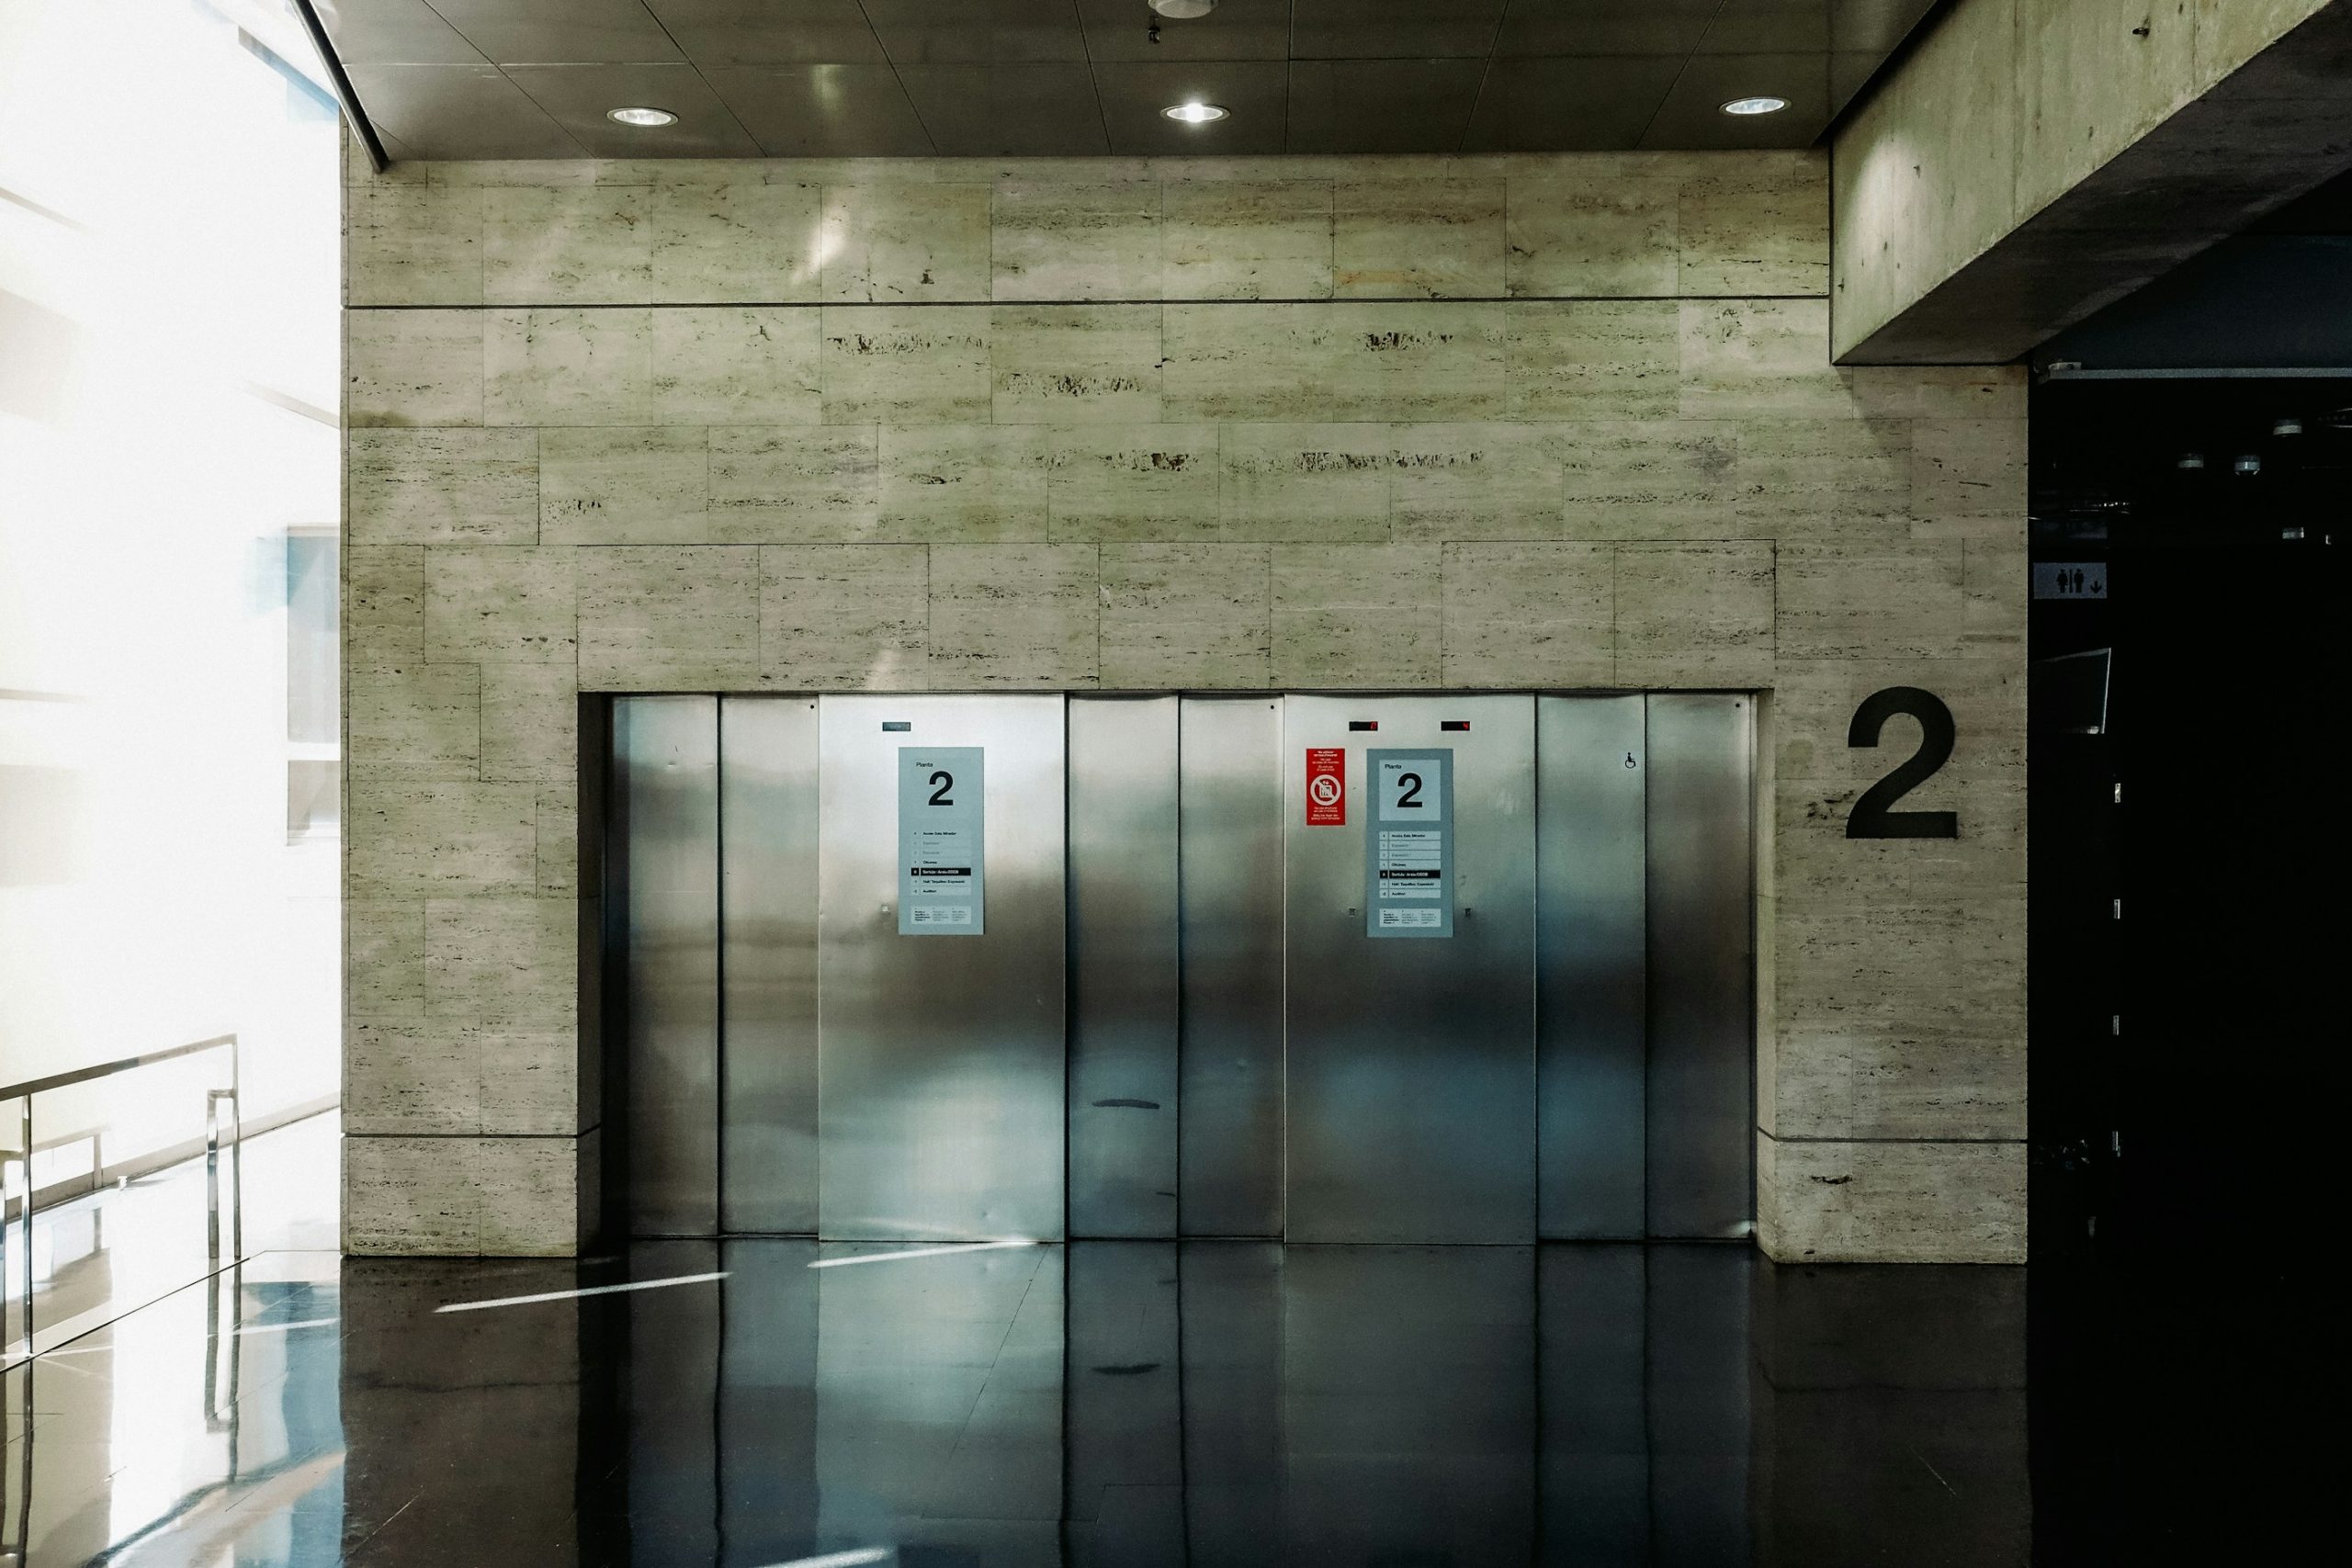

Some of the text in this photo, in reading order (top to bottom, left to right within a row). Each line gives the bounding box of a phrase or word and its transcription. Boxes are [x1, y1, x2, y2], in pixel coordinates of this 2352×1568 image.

[1847, 687, 1957, 839] 2
[928, 771, 954, 806] 2
[1396, 773, 1423, 807] 2
